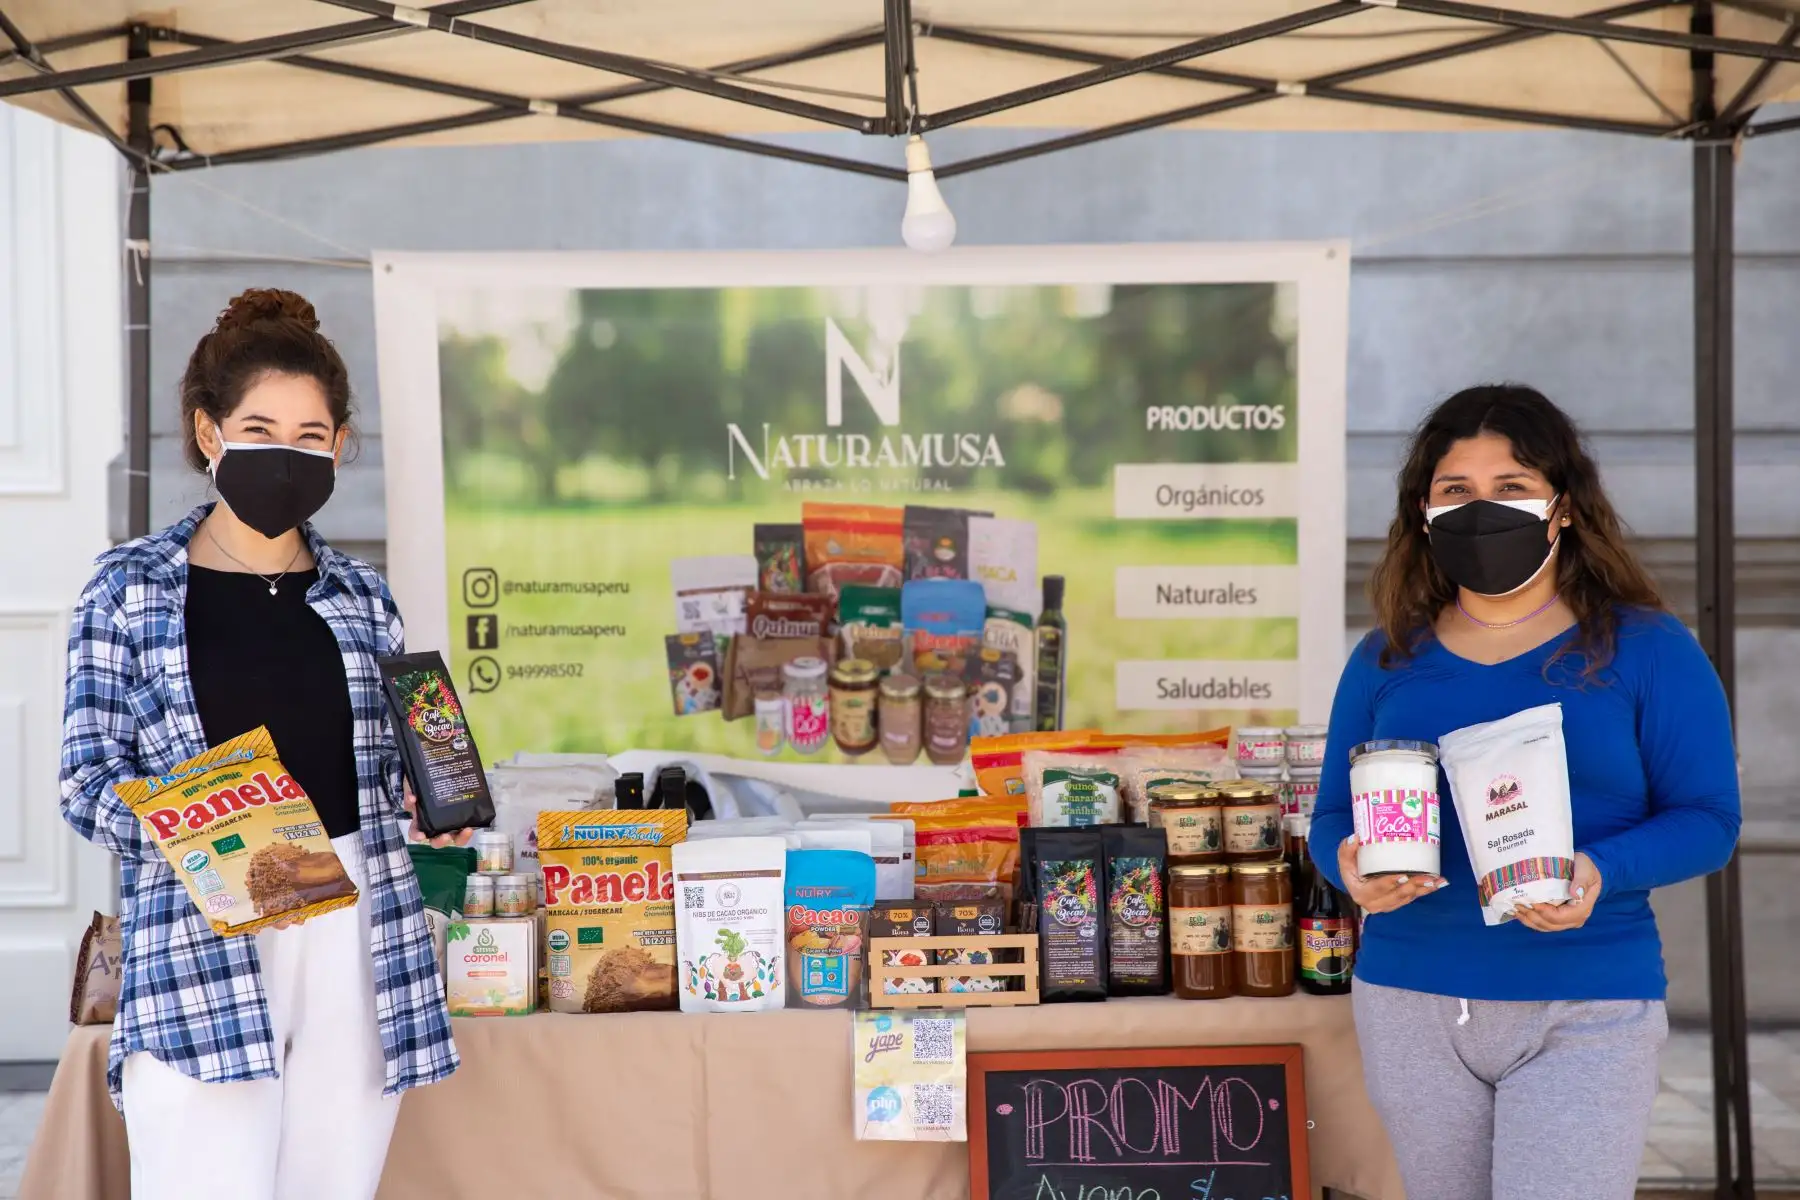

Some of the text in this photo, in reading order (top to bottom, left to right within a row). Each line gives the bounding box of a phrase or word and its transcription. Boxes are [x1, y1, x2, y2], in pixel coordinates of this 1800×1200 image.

[1146, 404, 1286, 430] PRODUCTOS
[1155, 483, 1265, 512] Orgánicos
[503, 580, 630, 597] @naturamusaperu
[1156, 583, 1258, 605] Naturales
[505, 624, 627, 639] /naturamusaperu
[1156, 677, 1272, 700] Saludables
[181, 770, 243, 799] 100% organic
[143, 772, 308, 842] Panela
[1485, 800, 1528, 822] MARASAL
[210, 812, 253, 833] SUGARCANE
[1487, 828, 1535, 849] Sal Rosada
[1497, 838, 1527, 853] Gourmet
[581, 854, 638, 867] 100% organic
[542, 860, 676, 906] Panela
[716, 909, 737, 917] CACAO
[789, 905, 859, 925] Cacao
[810, 925, 836, 933] POWDER
[463, 951, 508, 963] coronel
[865, 1032, 904, 1063] yape
[1024, 1075, 1264, 1162] PROMO
